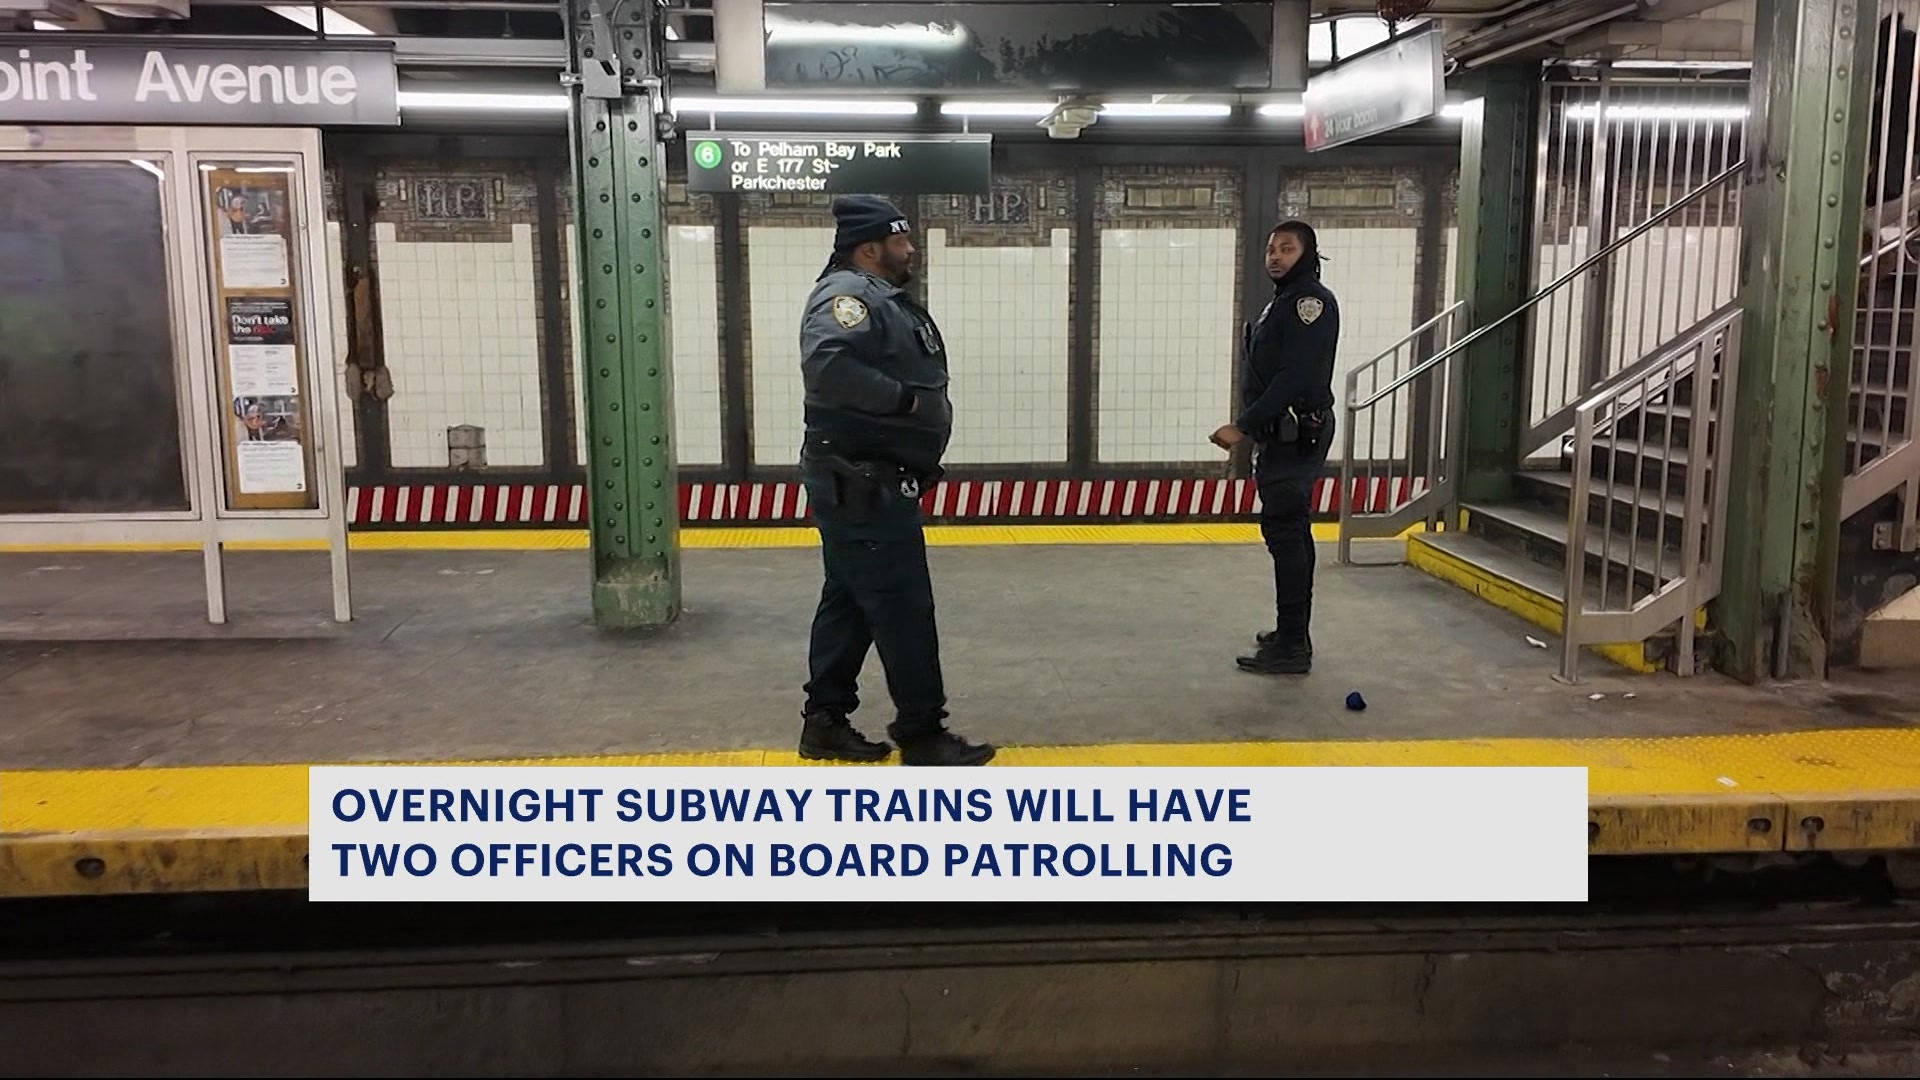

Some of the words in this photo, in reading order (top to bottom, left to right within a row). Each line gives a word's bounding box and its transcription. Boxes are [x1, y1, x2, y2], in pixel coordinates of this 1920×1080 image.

[135, 51, 358, 105] Avenue
[702, 147, 715, 163] 6
[731, 141, 751, 157] To
[759, 141, 818, 157] Pelham
[826, 141, 856, 161] Bay
[864, 142, 901, 158] Park
[731, 160, 748, 173] or
[757, 159, 768, 173] E
[777, 159, 805, 173] 177
[731, 175, 827, 191] Parkchester
